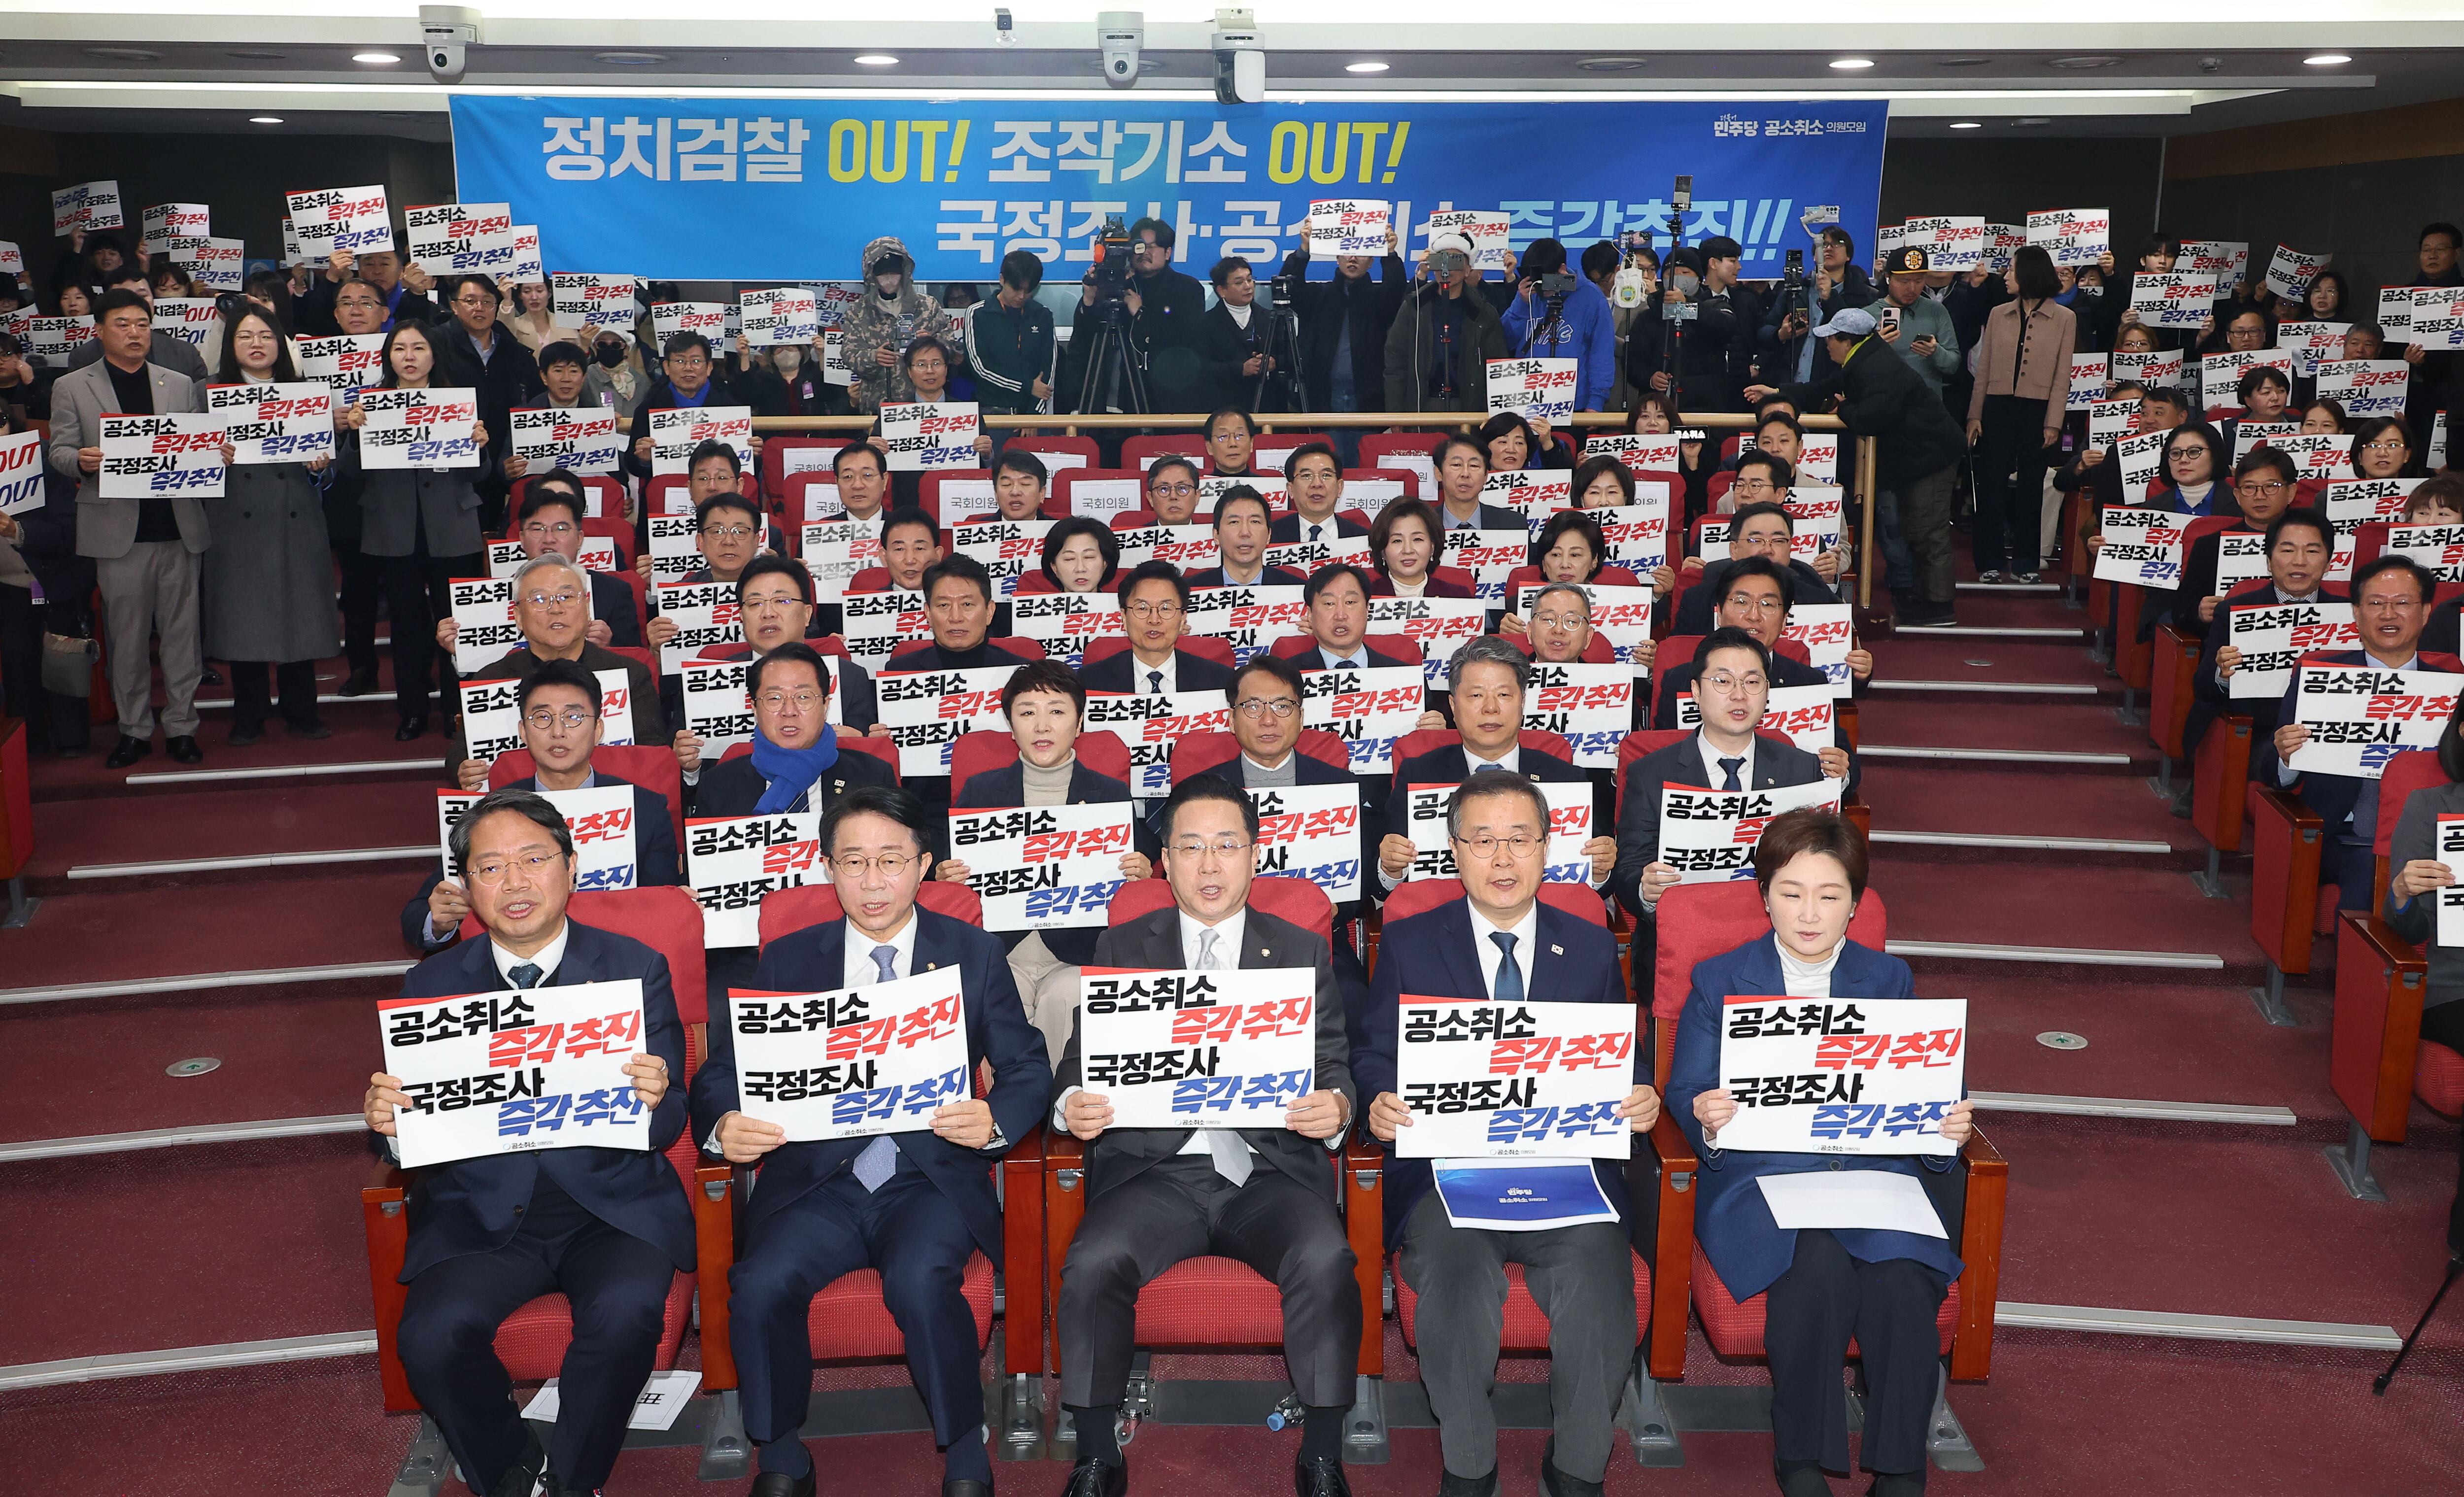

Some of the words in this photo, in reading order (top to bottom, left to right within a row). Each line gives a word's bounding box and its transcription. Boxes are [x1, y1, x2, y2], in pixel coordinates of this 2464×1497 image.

[1714, 121, 1758, 136] 민주당
[1765, 119, 1824, 136] 공소취소
[1826, 122, 1866, 133] 의원모임
[543, 116, 809, 182] 정치검찰
[829, 119, 970, 183] OUT!
[989, 120, 1247, 184] 조작기소
[1268, 122, 1409, 184] OUT!
[291, 191, 344, 211] 공소취소
[327, 201, 359, 220] 즉각
[357, 198, 384, 215] 추진
[1312, 202, 1355, 215] 공소취소
[144, 205, 178, 221] 공소취소
[409, 207, 466, 227] 공소취소
[1432, 213, 1476, 227] 공소취소
[2029, 212, 2075, 228] 공소취소
[298, 220, 351, 239] 국정조사
[449, 220, 479, 238] 즉각
[480, 217, 509, 235] 추진
[1908, 219, 1951, 233] 공소취소
[171, 238, 210, 249] 공소취소
[413, 238, 472, 258] 국정조사
[2276, 248, 2317, 269] 공소취소
[555, 276, 600, 288] 공소취소
[2135, 275, 2182, 289] 공소취소
[743, 291, 785, 306] 공소취소
[654, 305, 695, 318] 공소취소
[32, 318, 81, 332] 공소취소
[300, 338, 357, 358] 공소취소
[1490, 361, 1542, 379] 공소취소
[2205, 353, 2254, 370] 공소취소
[2320, 362, 2370, 376] 공소취소
[211, 386, 280, 408] 공소취소
[259, 400, 294, 420] 즉각
[295, 396, 330, 417] 추진
[362, 391, 426, 412] 공소취소
[1490, 390, 1544, 408] 국정조사
[406, 406, 440, 425] 즉각
[441, 403, 474, 422] 추진
[514, 411, 571, 429] 공소취소
[653, 411, 709, 429] 공소취소
[884, 405, 938, 422] 공소취소
[104, 418, 177, 438] 공소취소
[366, 426, 434, 446] 국정조사
[552, 423, 583, 441] 즉각
[152, 434, 190, 454] 즉각
[189, 432, 227, 451] 추진
[409, 442, 442, 460] 즉각
[1586, 437, 1639, 453] 공소취소
[2269, 437, 2331, 454] 공소취소
[104, 455, 177, 475] 국정조사
[151, 471, 188, 490] 즉각
[188, 467, 223, 486] 추진
[1508, 486, 1540, 505] 즉각
[1539, 483, 1570, 501] 추진
[2331, 481, 2400, 501] 공소취소
[951, 496, 998, 509] 국회의원
[1082, 497, 1129, 509] 국회의원
[1631, 519, 1664, 540] 추진
[2105, 511, 2169, 528] 공소취소
[957, 524, 1021, 545] 공소취소
[1114, 529, 1174, 549] 공소취소
[1000, 538, 1034, 559] 즉각
[1153, 543, 1187, 561] 즉각
[1186, 538, 1219, 560] 추진
[1266, 543, 1330, 566] 공소취소
[2101, 544, 2167, 561] 국정조사
[579, 551, 613, 570] 추진
[661, 585, 738, 610] 공소취소
[847, 594, 922, 616] 공소취소
[1016, 596, 1088, 618] 공소취소
[1187, 590, 1255, 613] 공소취소
[1063, 612, 1103, 635] 즉각
[1230, 605, 1269, 628] 즉각
[1269, 602, 1310, 625] 추진
[1609, 604, 1649, 626] 추진
[2234, 607, 2321, 632] 공소취소
[1404, 618, 1444, 639] 즉각
[1443, 616, 1483, 638] 추진
[1809, 621, 1850, 645] 추진
[2291, 623, 2338, 647] 즉각
[882, 673, 967, 702] 공소취소
[2304, 671, 2405, 694] 공소취소
[939, 692, 984, 719] 즉각
[1332, 691, 1377, 718] 즉각
[1377, 686, 1422, 714] 추진
[1538, 686, 1585, 712] 즉각
[1584, 683, 1631, 709] 추진
[2366, 695, 2424, 720] 즉각
[1088, 697, 1172, 721] 공소취소
[1787, 704, 1831, 734] 추진
[1667, 794, 1772, 820] 공소취소
[574, 808, 631, 844] 추진
[955, 810, 1056, 845] 공소취소
[1304, 806, 1357, 839] 추진
[692, 818, 797, 856] 공소취소
[1023, 831, 1077, 863] 즉각
[1077, 823, 1130, 856] 추진
[763, 839, 819, 874] 즉각
[1311, 859, 1358, 889] 추진
[1026, 885, 1079, 918] 즉각
[1088, 976, 1217, 1014] 공소취소
[390, 995, 535, 1047] 공소취소
[738, 992, 869, 1033] 공소취소
[1171, 1005, 1243, 1045] 즉각
[1241, 996, 1312, 1040] 추진
[1729, 1004, 1865, 1039] 공소취소
[826, 1016, 897, 1060] 즉각
[897, 993, 960, 1049] 추진
[1405, 1007, 1536, 1042] 공소취소
[489, 1023, 564, 1068] 즉각
[565, 1009, 640, 1058] 추진
[1815, 1034, 1891, 1070] 즉각
[1888, 1028, 1962, 1069] 추진
[1490, 1037, 1561, 1075] 즉각
[1560, 1032, 1632, 1071] 추진
[1088, 1046, 1220, 1087] 국정조사
[398, 1067, 545, 1115] 국정조사
[745, 1059, 877, 1102] 국정조사
[1172, 1076, 1243, 1113] 즉각
[1241, 1068, 1312, 1109] 추진
[1728, 1073, 1864, 1108] 국정조사
[832, 1085, 903, 1124] 즉각
[1404, 1077, 1537, 1115] 국정조사
[498, 1094, 573, 1136] 즉각
[574, 1086, 643, 1126] 추진
[1811, 1104, 1886, 1139] 즉각
[1487, 1106, 1560, 1143] 즉각
